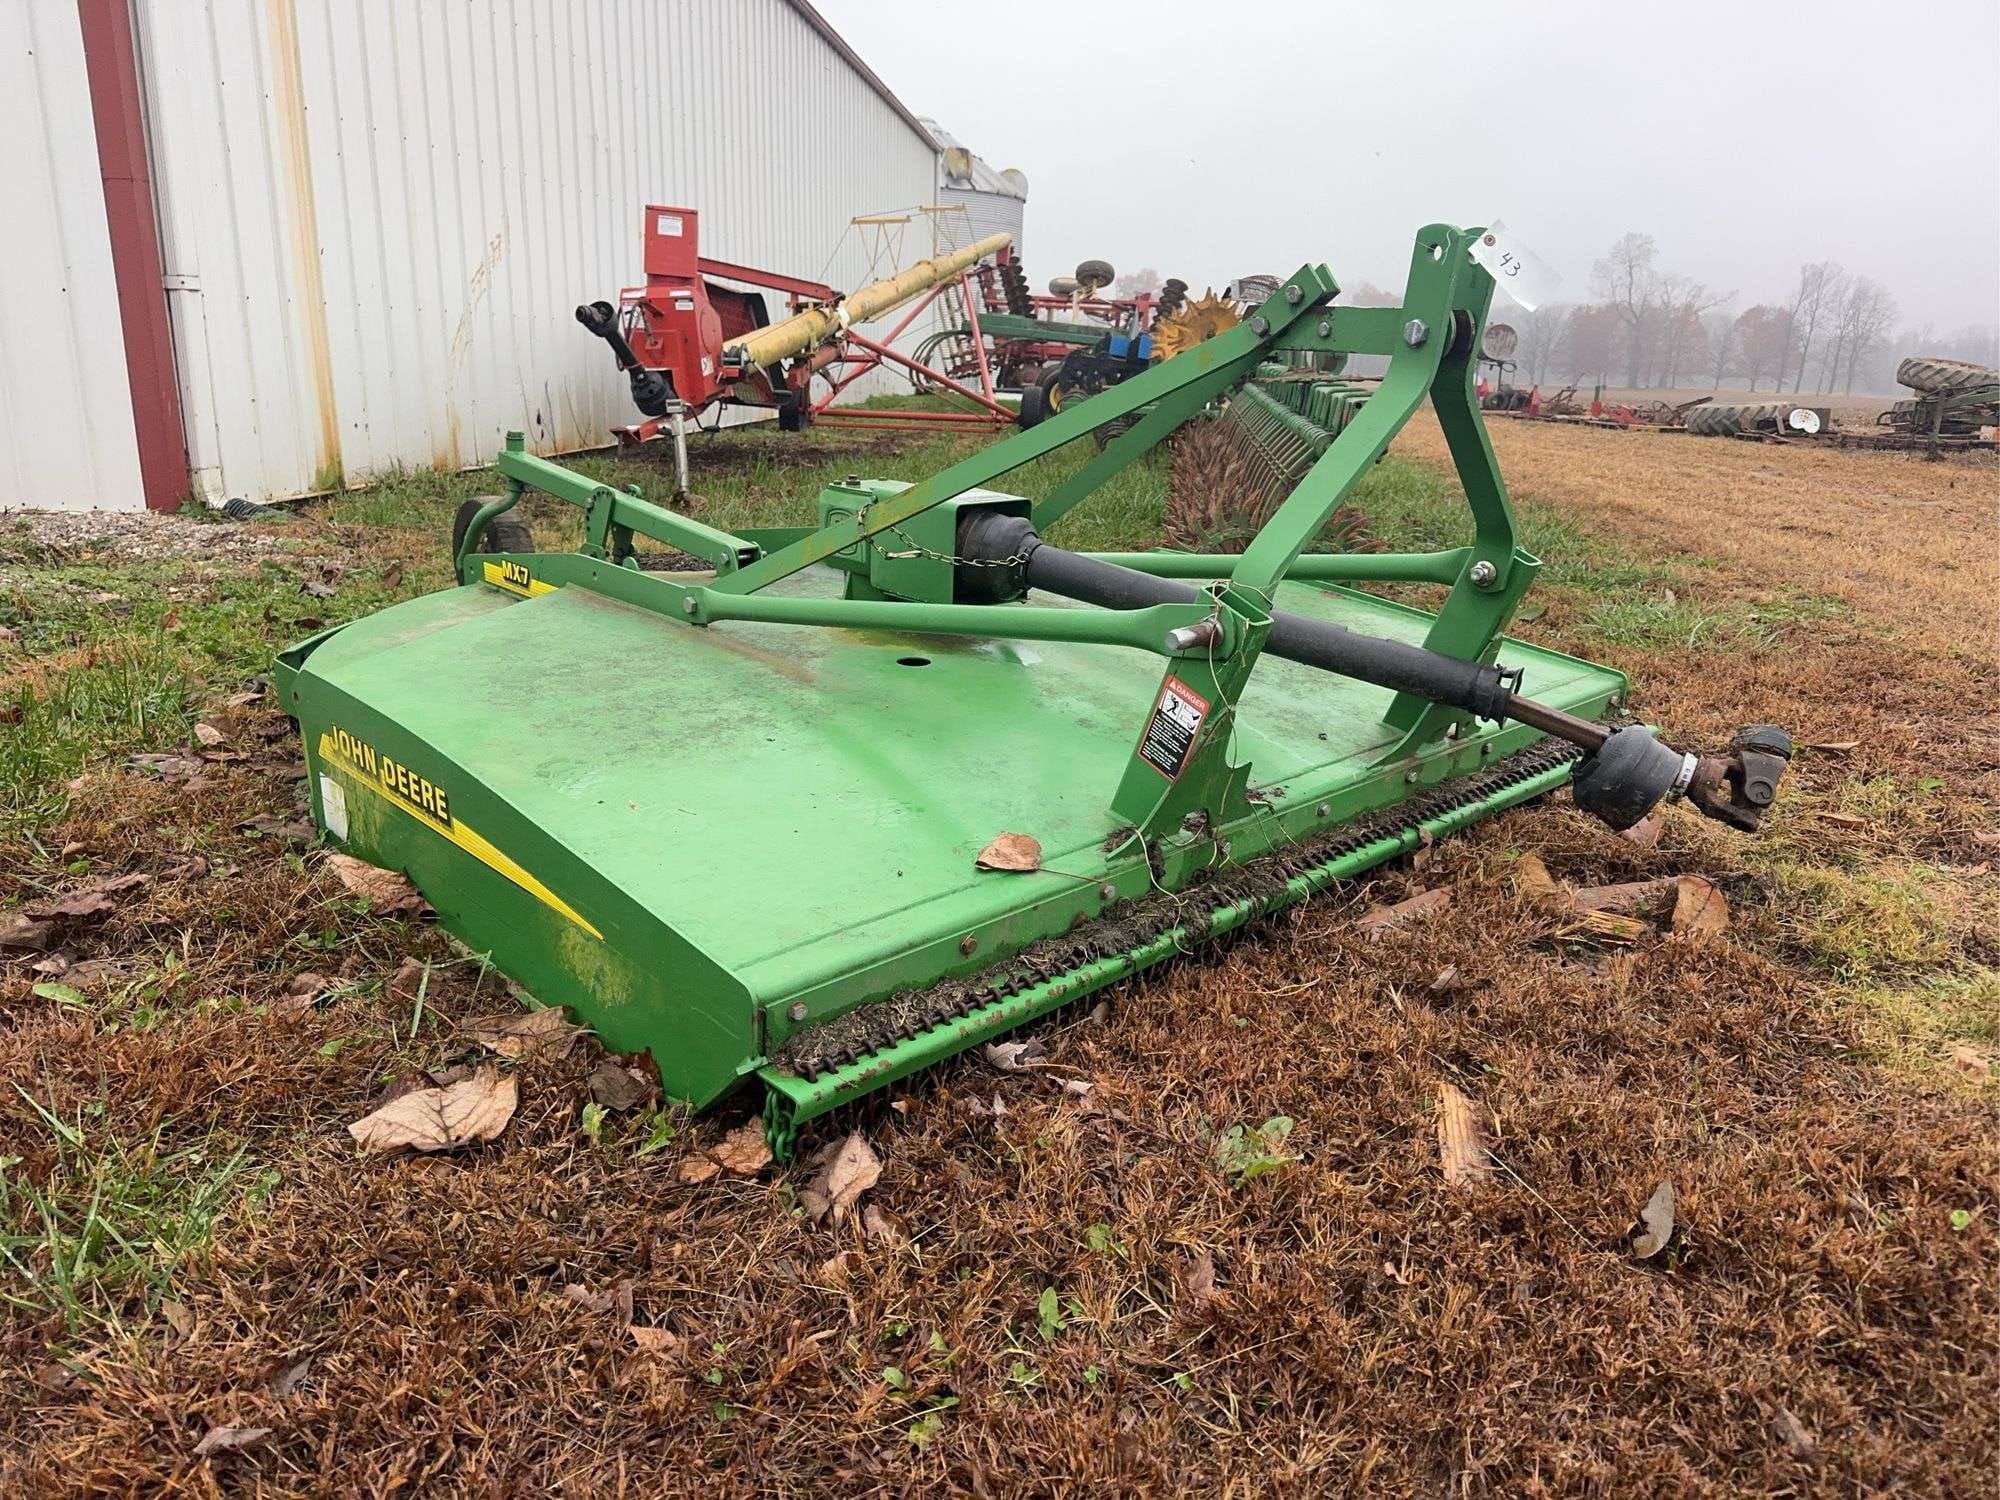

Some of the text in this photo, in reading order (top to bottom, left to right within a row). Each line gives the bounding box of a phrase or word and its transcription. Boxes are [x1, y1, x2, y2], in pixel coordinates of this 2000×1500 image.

[1499, 251, 1521, 277] 43
[501, 559, 529, 585] MX7
[1176, 686, 1206, 710] DANGER
[328, 724, 449, 821] JOHN DEERE
